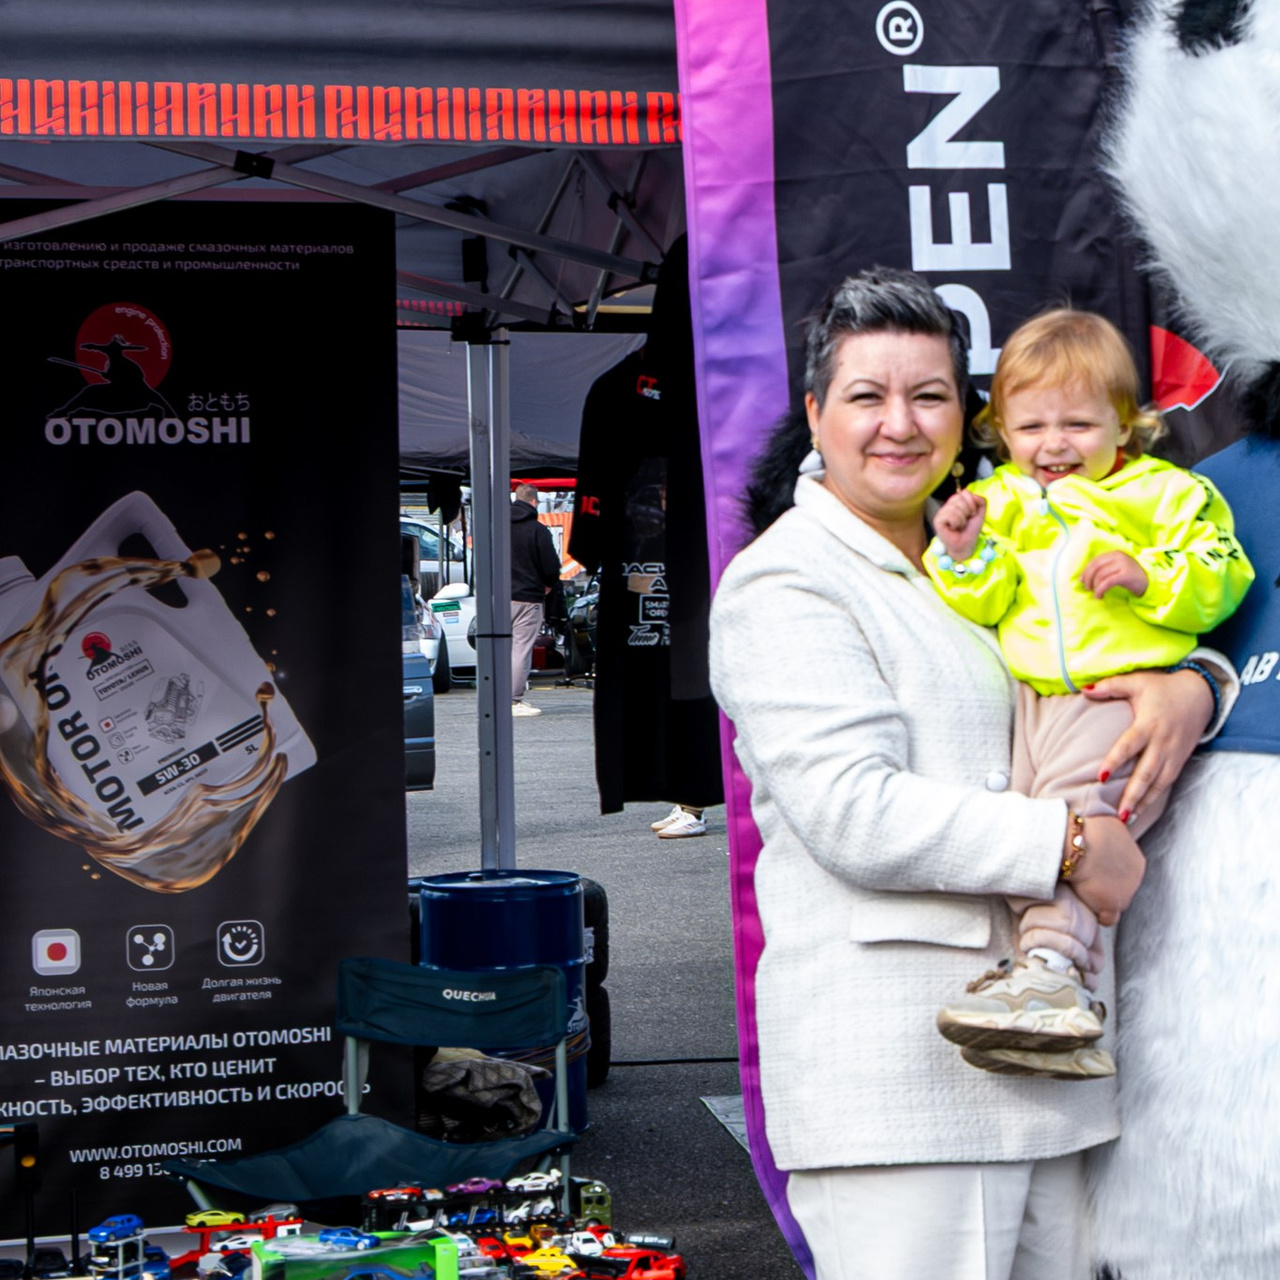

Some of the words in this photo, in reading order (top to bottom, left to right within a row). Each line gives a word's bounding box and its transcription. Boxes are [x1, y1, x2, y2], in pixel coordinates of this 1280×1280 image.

[3, 241, 107, 252] изготовлению
[110, 242, 120, 252] и
[122, 242, 186, 254] продаже
[188, 243, 267, 253] смазочных
[270, 243, 355, 255] материалов
[103, 259, 160, 270] средств
[175, 260, 300, 272] промышленности
[44, 416, 252, 445] OTOMOSHI
[85, 646, 143, 681] OTOMOSHI
[58, 710, 144, 833] MOTOR
[155, 753, 201, 785] 5W-30
[132, 981, 169, 992] Новая
[201, 977, 243, 990] Долгая
[245, 975, 282, 986] жизнь
[29, 984, 86, 997] Японская
[212, 990, 272, 1003] двигателя
[24, 999, 92, 1012] технология
[125, 994, 178, 1009] формула
[104, 1031, 229, 1056] МАТЕРИАЛЫ
[232, 1026, 332, 1048] OTOMOSHI
[50, 1066, 120, 1088] ВЫБОР
[123, 1064, 166, 1083] ТЕХ,
[169, 1061, 208, 1080] КТО
[212, 1057, 278, 1079] ЦЕНИТ
[81, 1087, 253, 1114] ЭФФЕКТИВНОСТЬ
[257, 1085, 271, 1101] И
[69, 1138, 242, 1163] WWW.OTOMOSHI.COM
[100, 1166, 110, 1179] 8
[113, 1164, 143, 1178] 499
